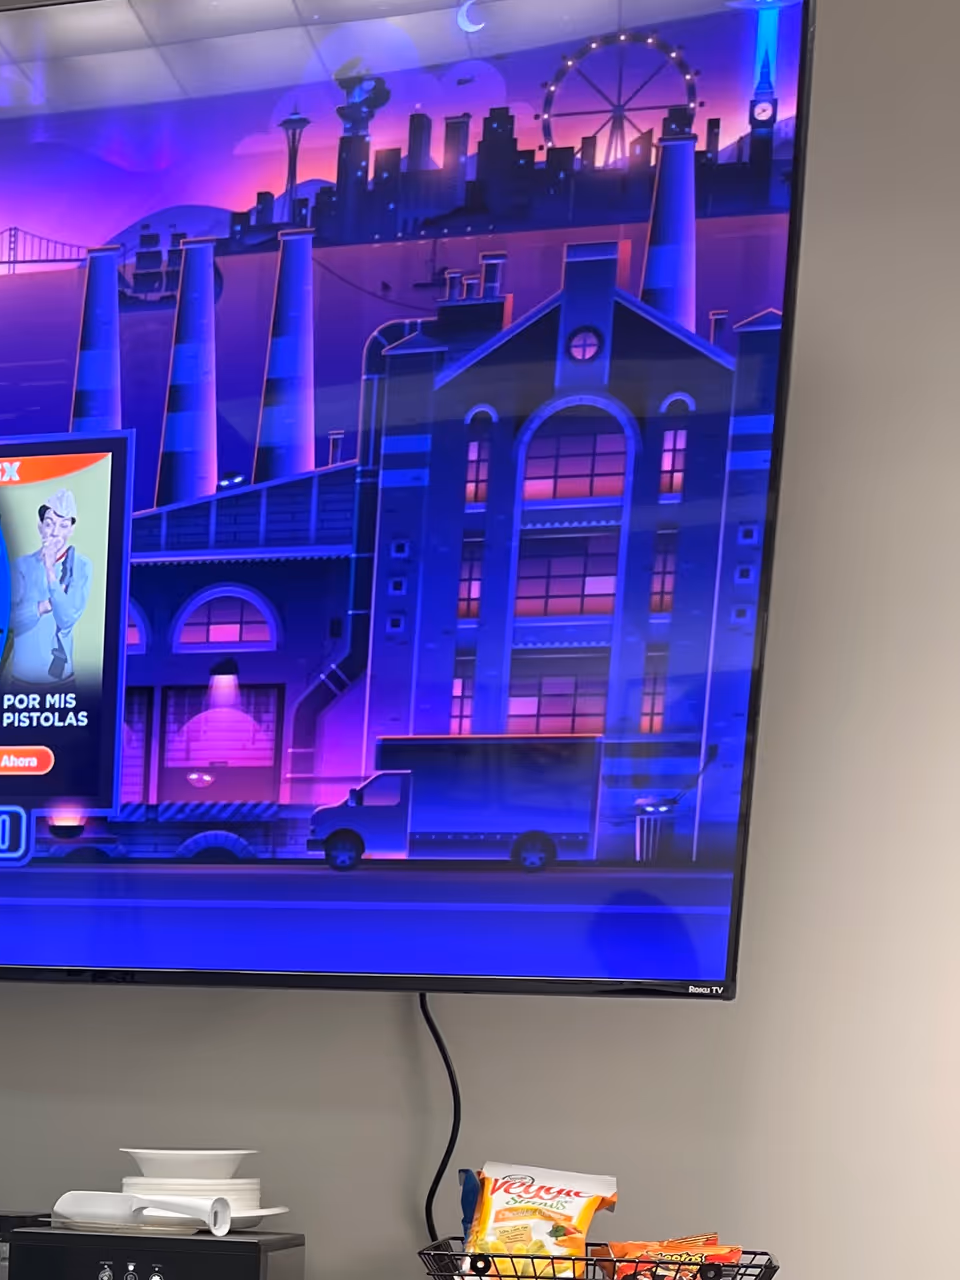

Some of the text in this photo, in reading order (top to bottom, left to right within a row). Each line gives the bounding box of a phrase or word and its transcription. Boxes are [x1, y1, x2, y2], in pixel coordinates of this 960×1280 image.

[2, 693, 76, 710] POR MIS
[2, 711, 89, 728] PISTOLAS
[0, 755, 38, 768] Ahora
[711, 986, 724, 994] TV
